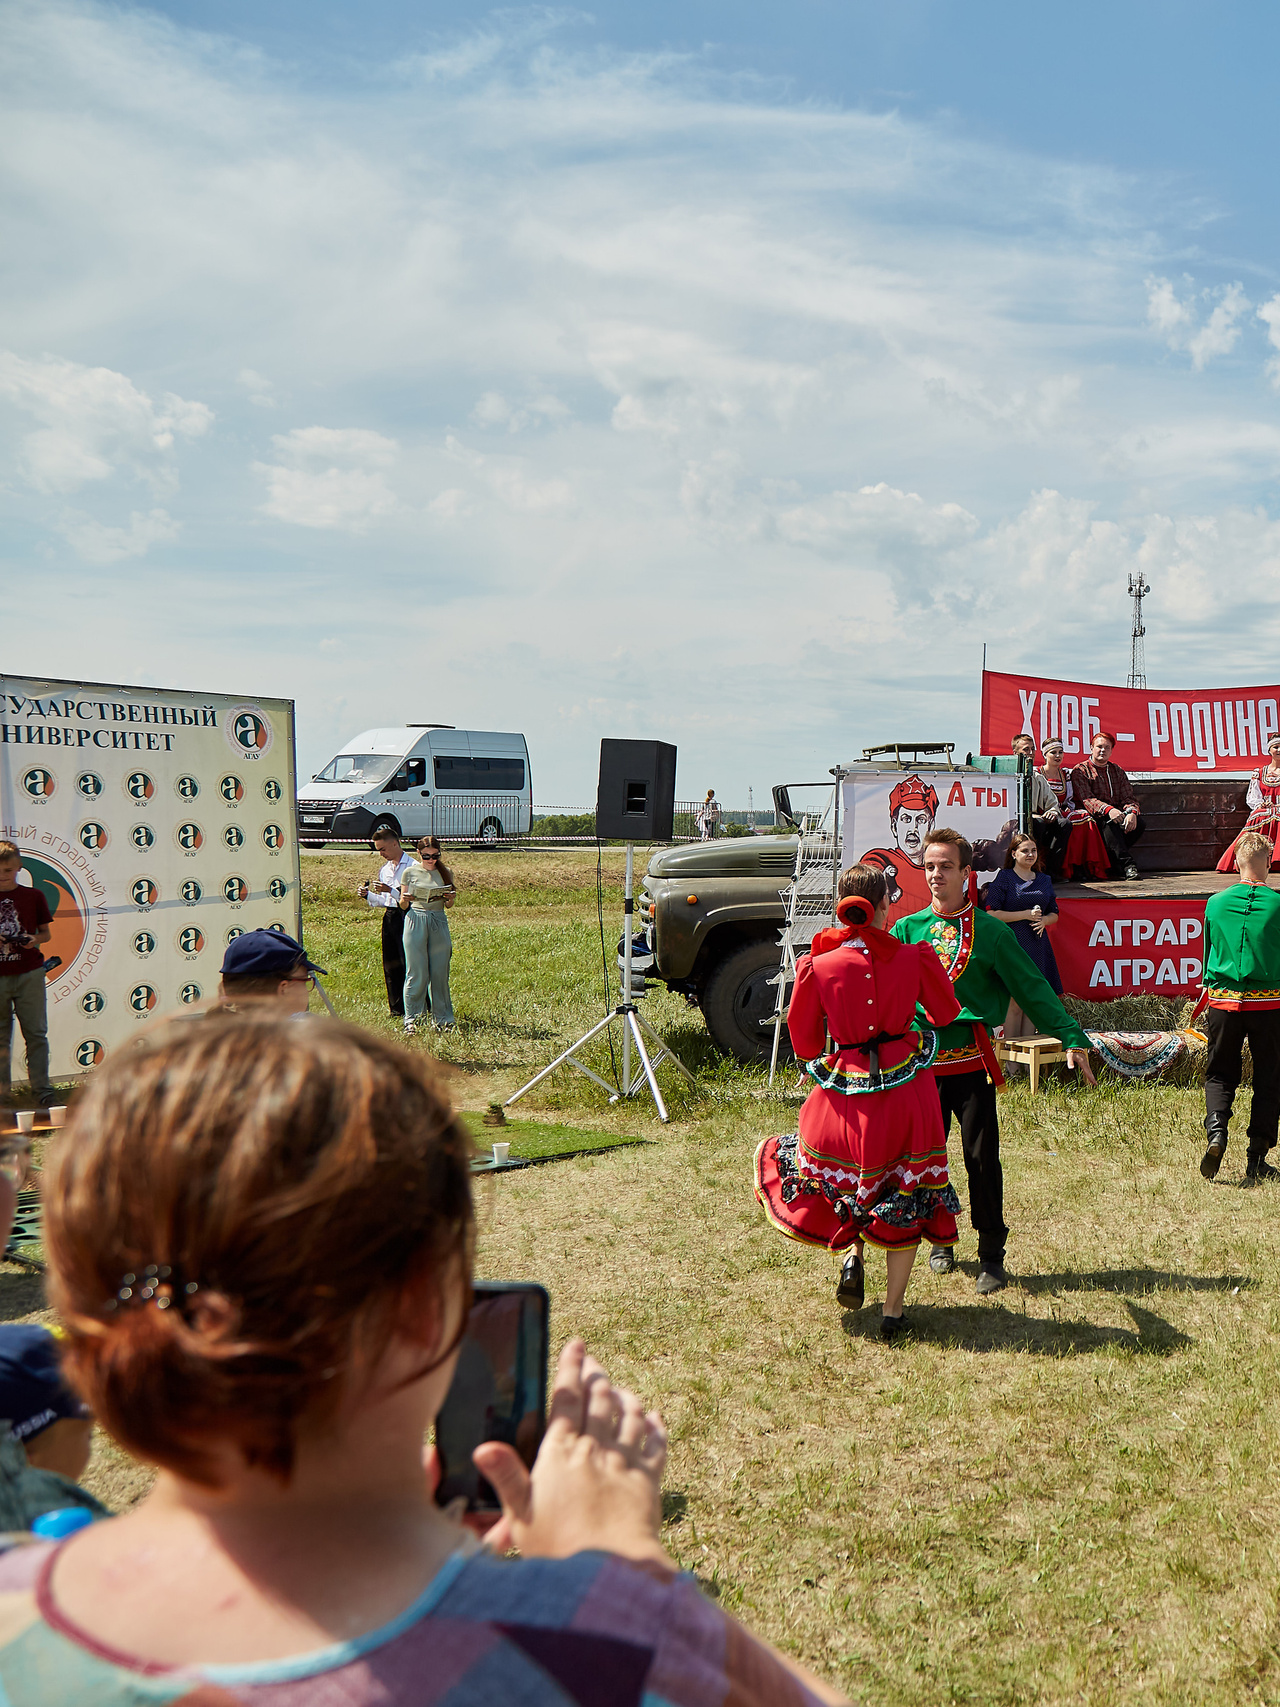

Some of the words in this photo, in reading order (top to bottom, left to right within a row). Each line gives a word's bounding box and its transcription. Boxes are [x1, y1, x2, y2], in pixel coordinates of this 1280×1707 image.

[946, 781, 966, 807] А
[41, 831, 107, 898] аграрный
[1088, 918, 1203, 947] АГРАР
[53, 901, 108, 1004] университет
[1088, 957, 1203, 987] АГРАР
